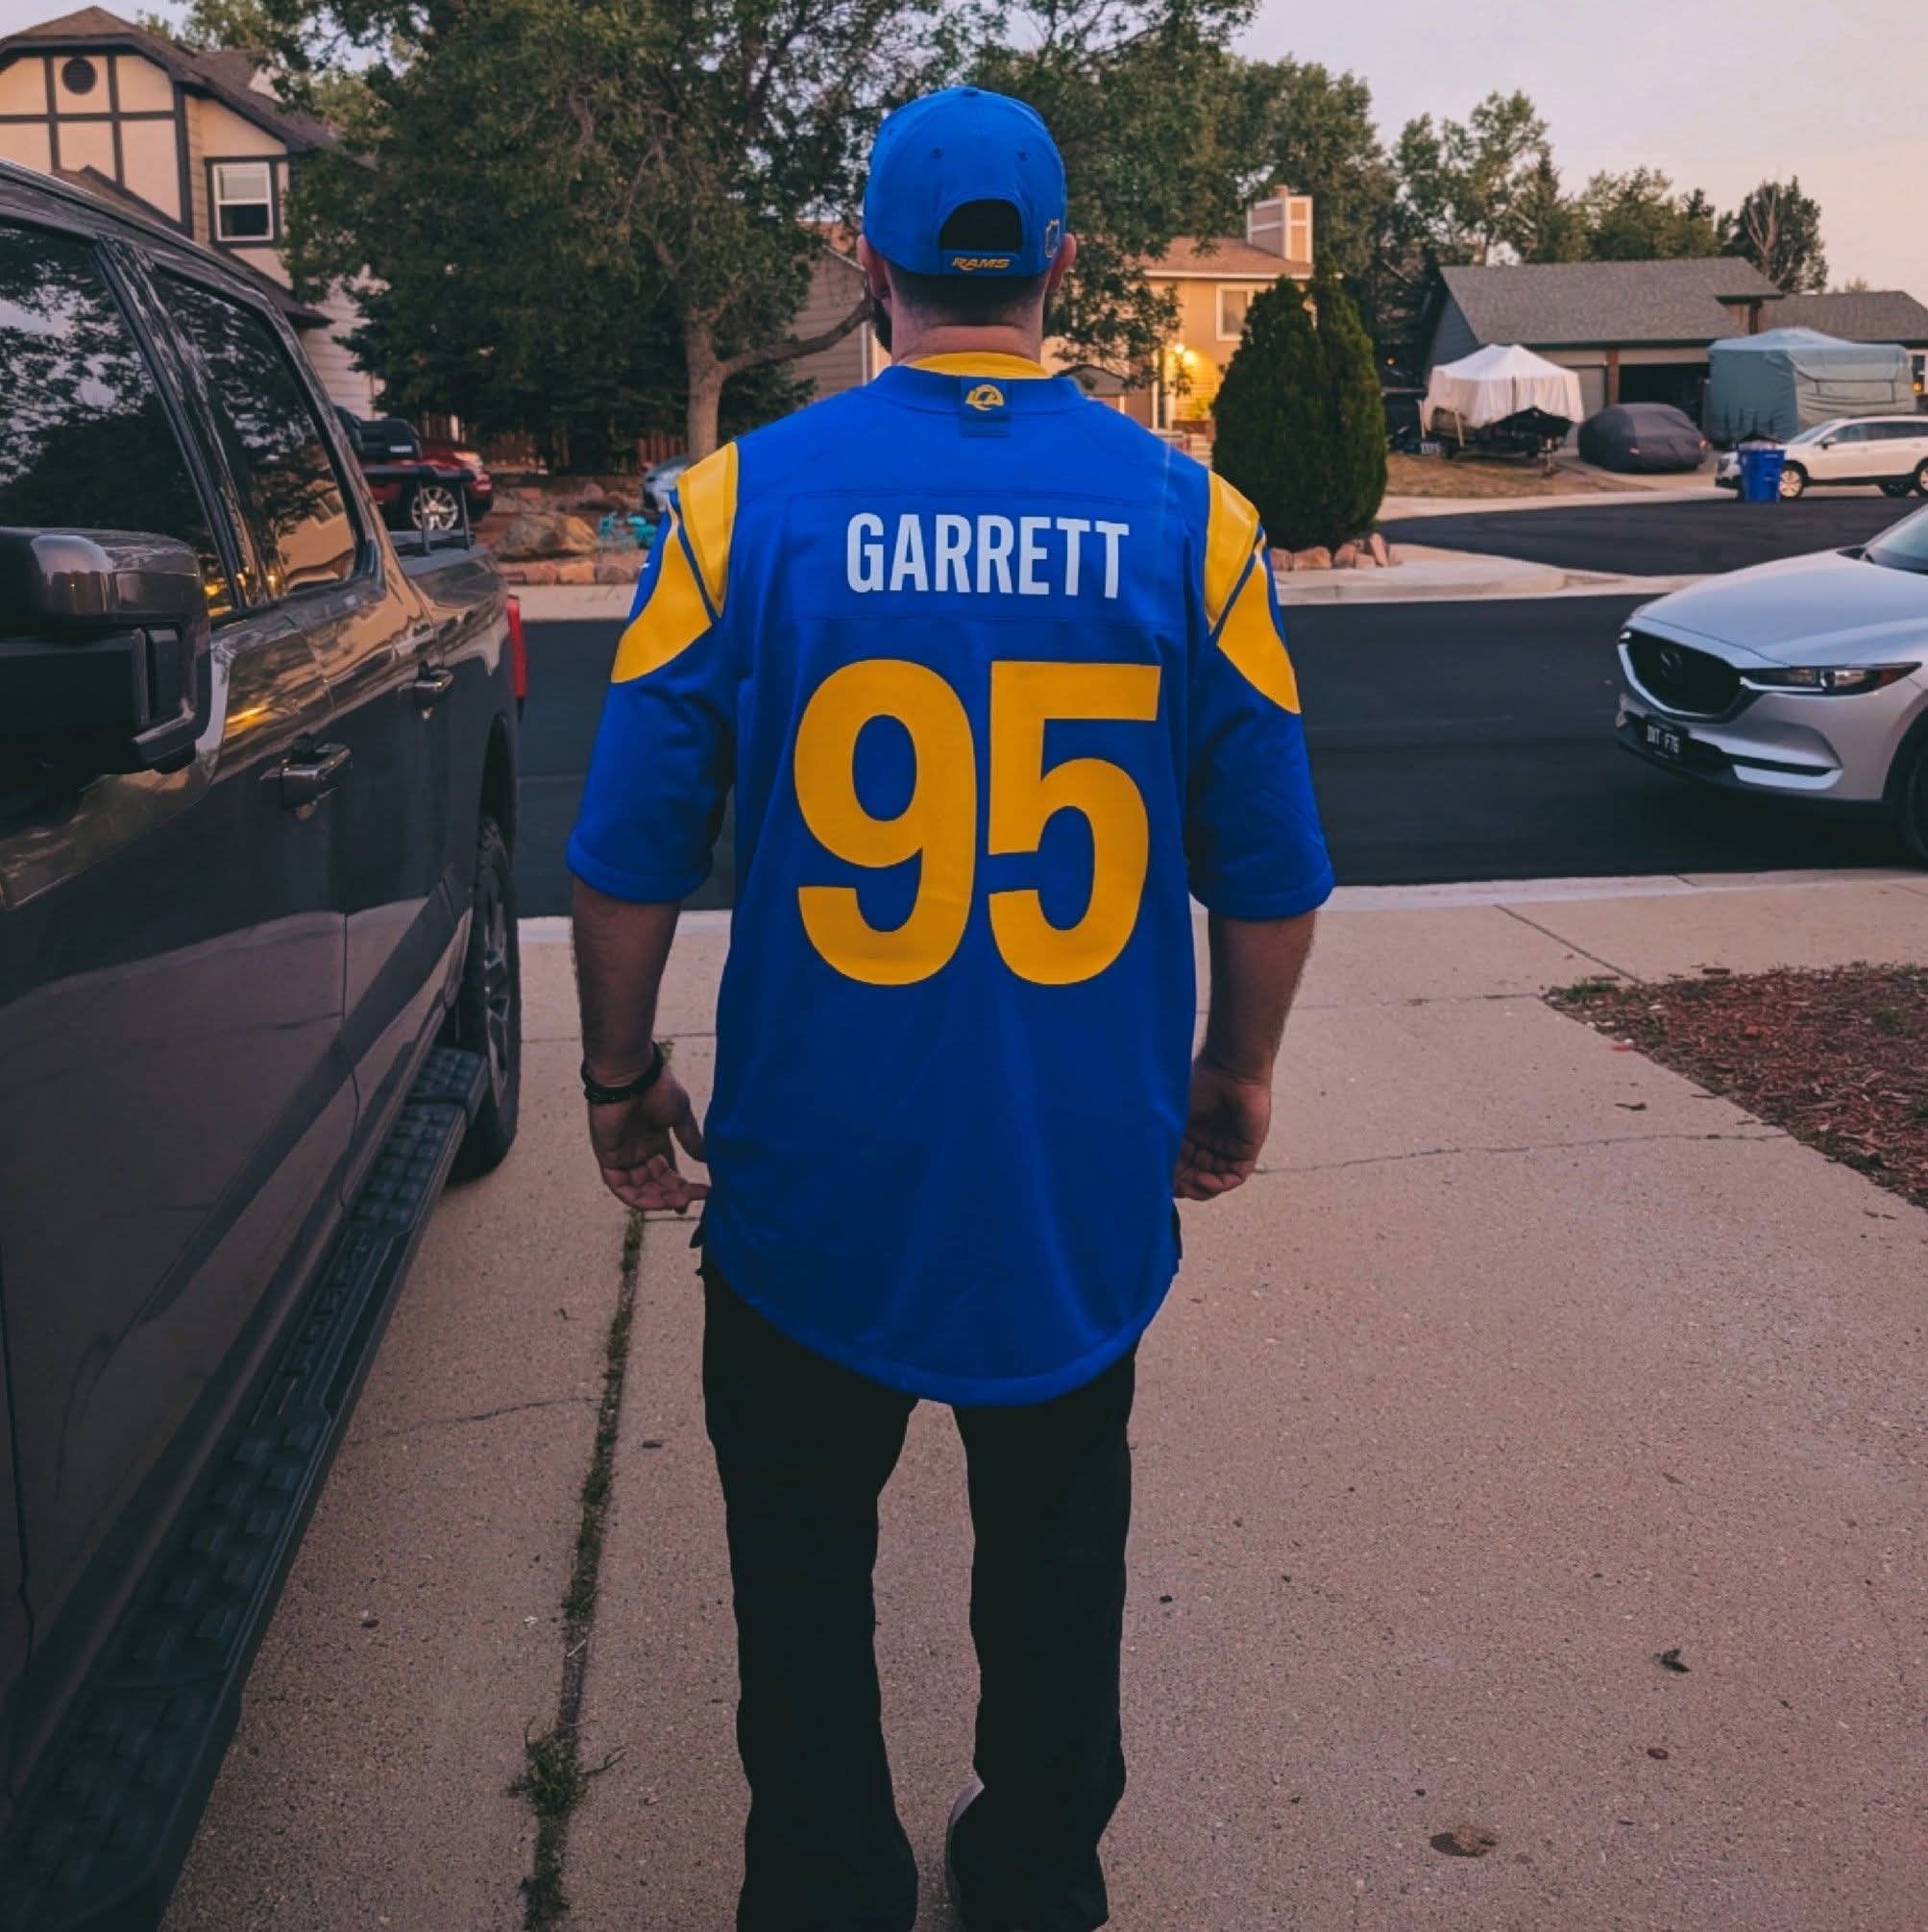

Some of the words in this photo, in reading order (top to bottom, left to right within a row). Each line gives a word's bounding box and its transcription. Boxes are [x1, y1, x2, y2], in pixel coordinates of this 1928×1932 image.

[952, 257, 1011, 271] RAMS
[847, 512, 1130, 599] GARRETT
[793, 658, 1161, 986] 95
